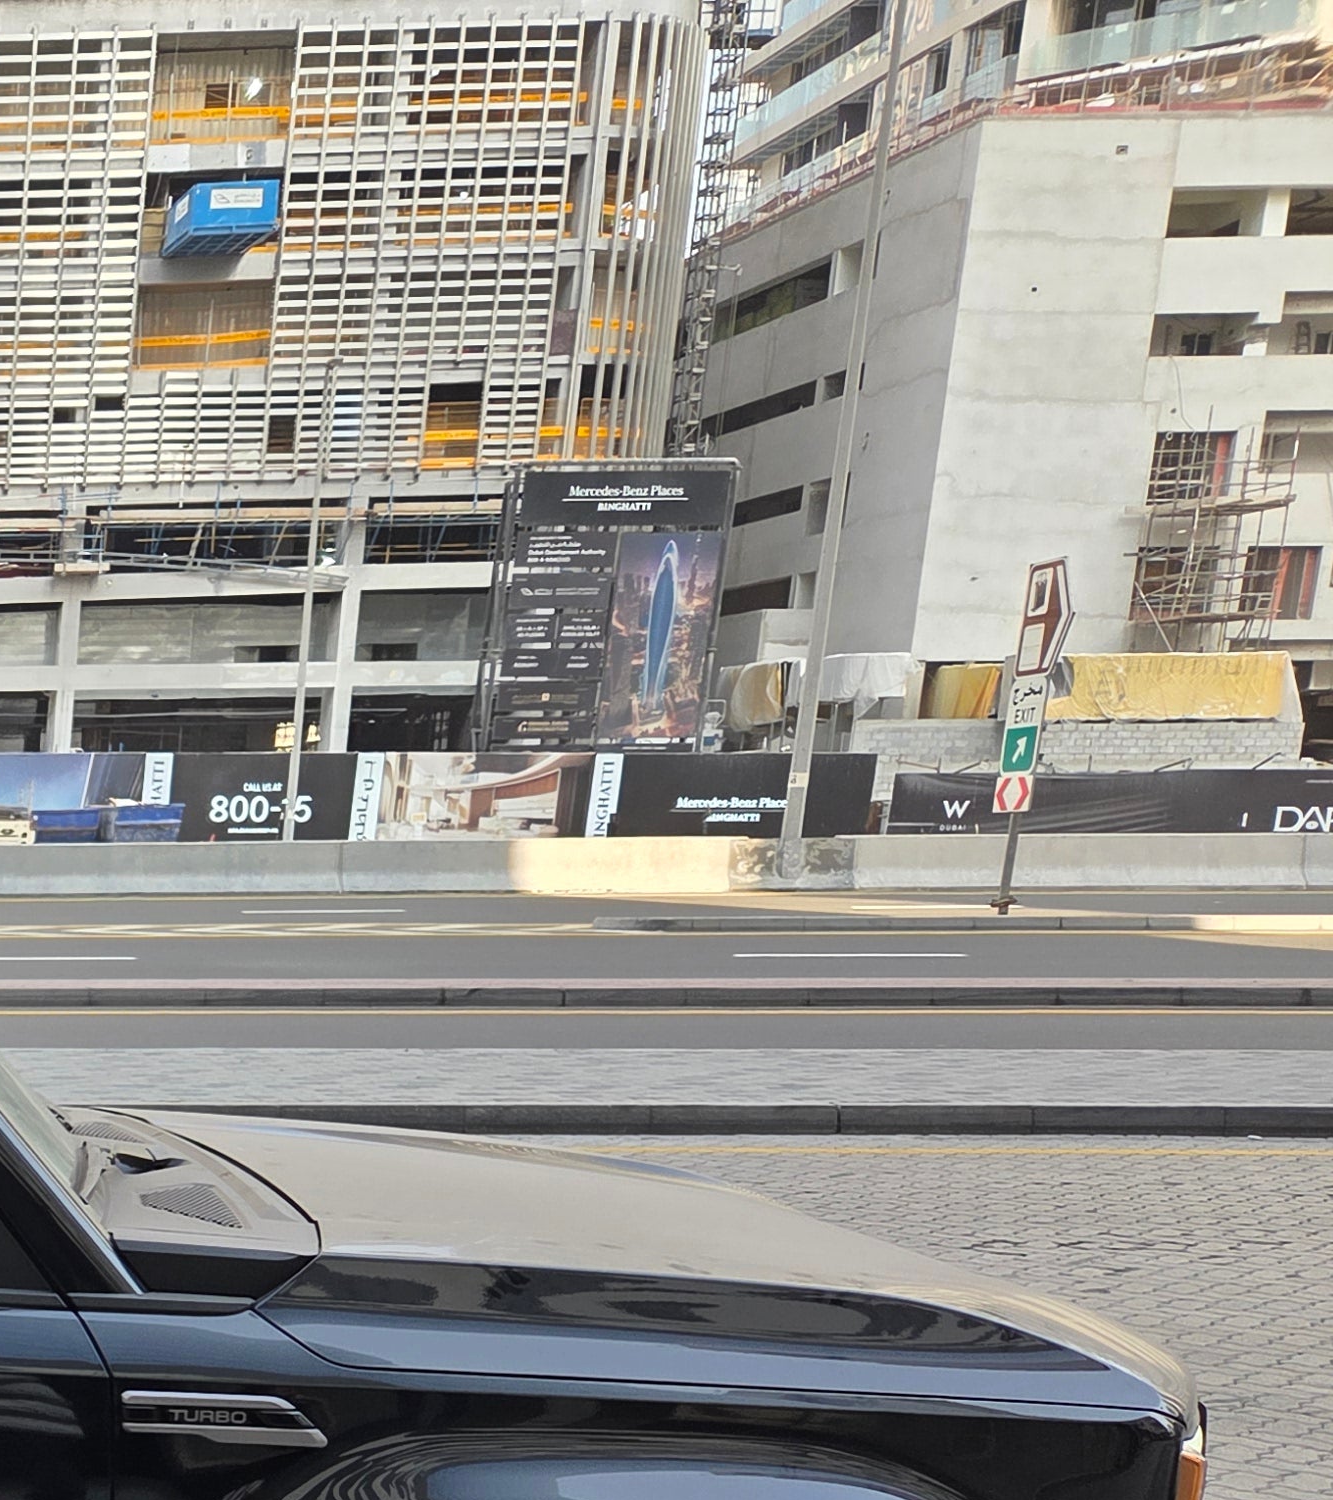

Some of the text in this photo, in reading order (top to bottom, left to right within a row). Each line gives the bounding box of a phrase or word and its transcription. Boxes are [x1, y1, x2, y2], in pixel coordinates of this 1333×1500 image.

[569, 485, 684, 497] Mercedes-Benz Places
[597, 502, 652, 512] BINGHATTI
[1013, 682, 1043, 706] مخرج
[1014, 707, 1037, 724] EXIT
[209, 795, 313, 824] 800-5
[943, 800, 971, 818] W
[169, 1408, 247, 1424] TURBO
